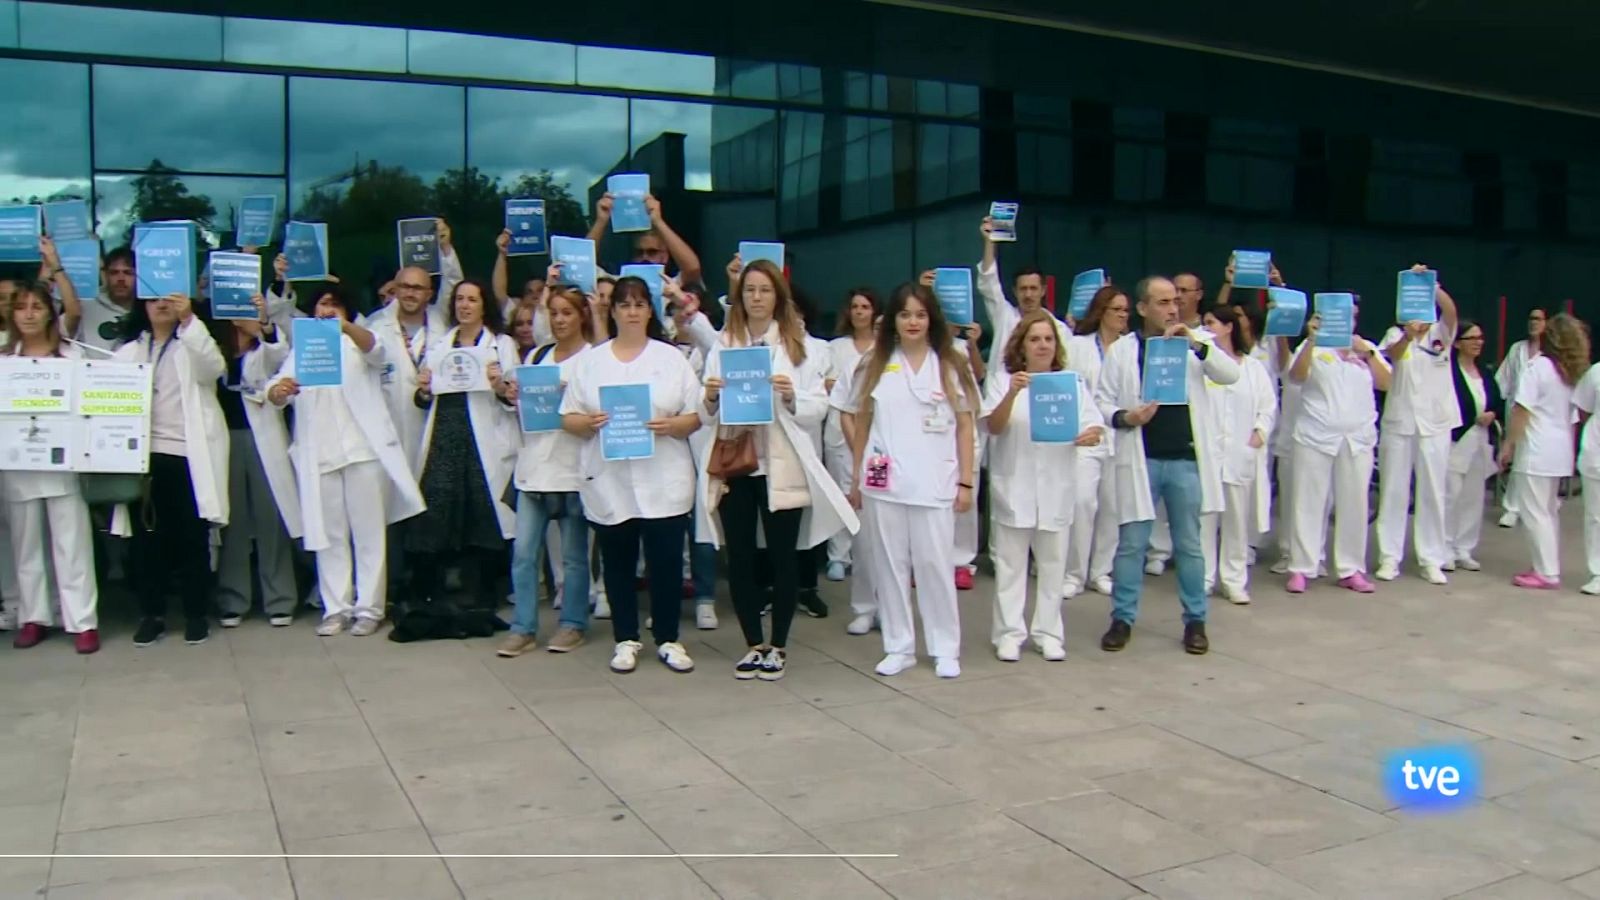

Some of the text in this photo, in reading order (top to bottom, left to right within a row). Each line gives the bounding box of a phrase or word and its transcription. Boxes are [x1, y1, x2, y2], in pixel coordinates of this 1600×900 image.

[508, 207, 544, 215] GRUPO
[404, 234, 434, 243] GRUPO
[143, 248, 181, 257] GRUPO
[1150, 357, 1182, 365] GRUPO
[726, 370, 766, 379] GRUPO
[523, 386, 556, 394] GRUPO
[82, 392, 144, 400] SANITARIOS
[1035, 393, 1072, 402] GRUPO
[82, 405, 144, 414] SUPERIORES
